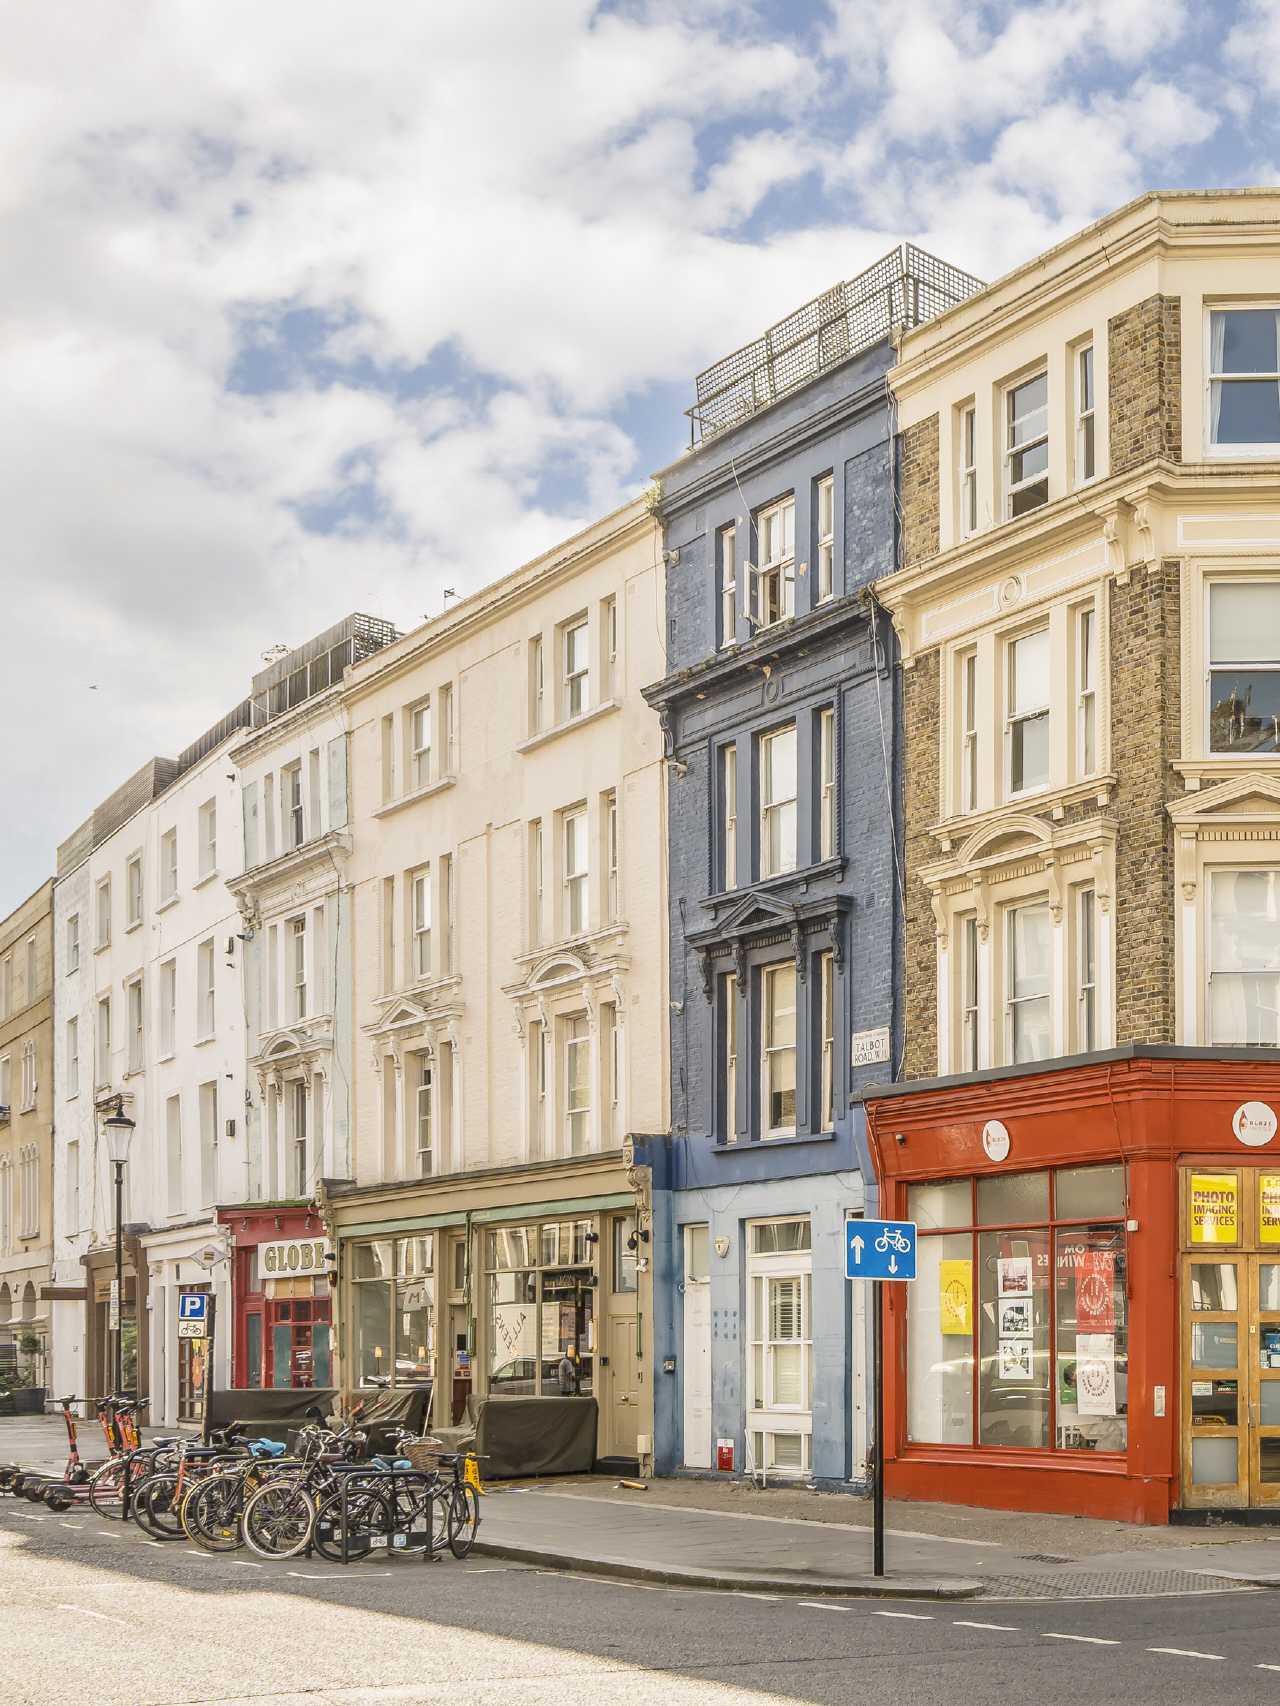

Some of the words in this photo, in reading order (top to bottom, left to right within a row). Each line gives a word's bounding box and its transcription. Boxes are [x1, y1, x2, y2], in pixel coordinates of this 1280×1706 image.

[855, 1039, 885, 1053] TALBOT
[1193, 1191, 1235, 1203] PHOTO
[1193, 1204, 1235, 1214] IMAGING
[1193, 1215, 1235, 1226] SERVICES
[264, 1242, 325, 1273] GLOBE
[185, 1296, 200, 1316] P
